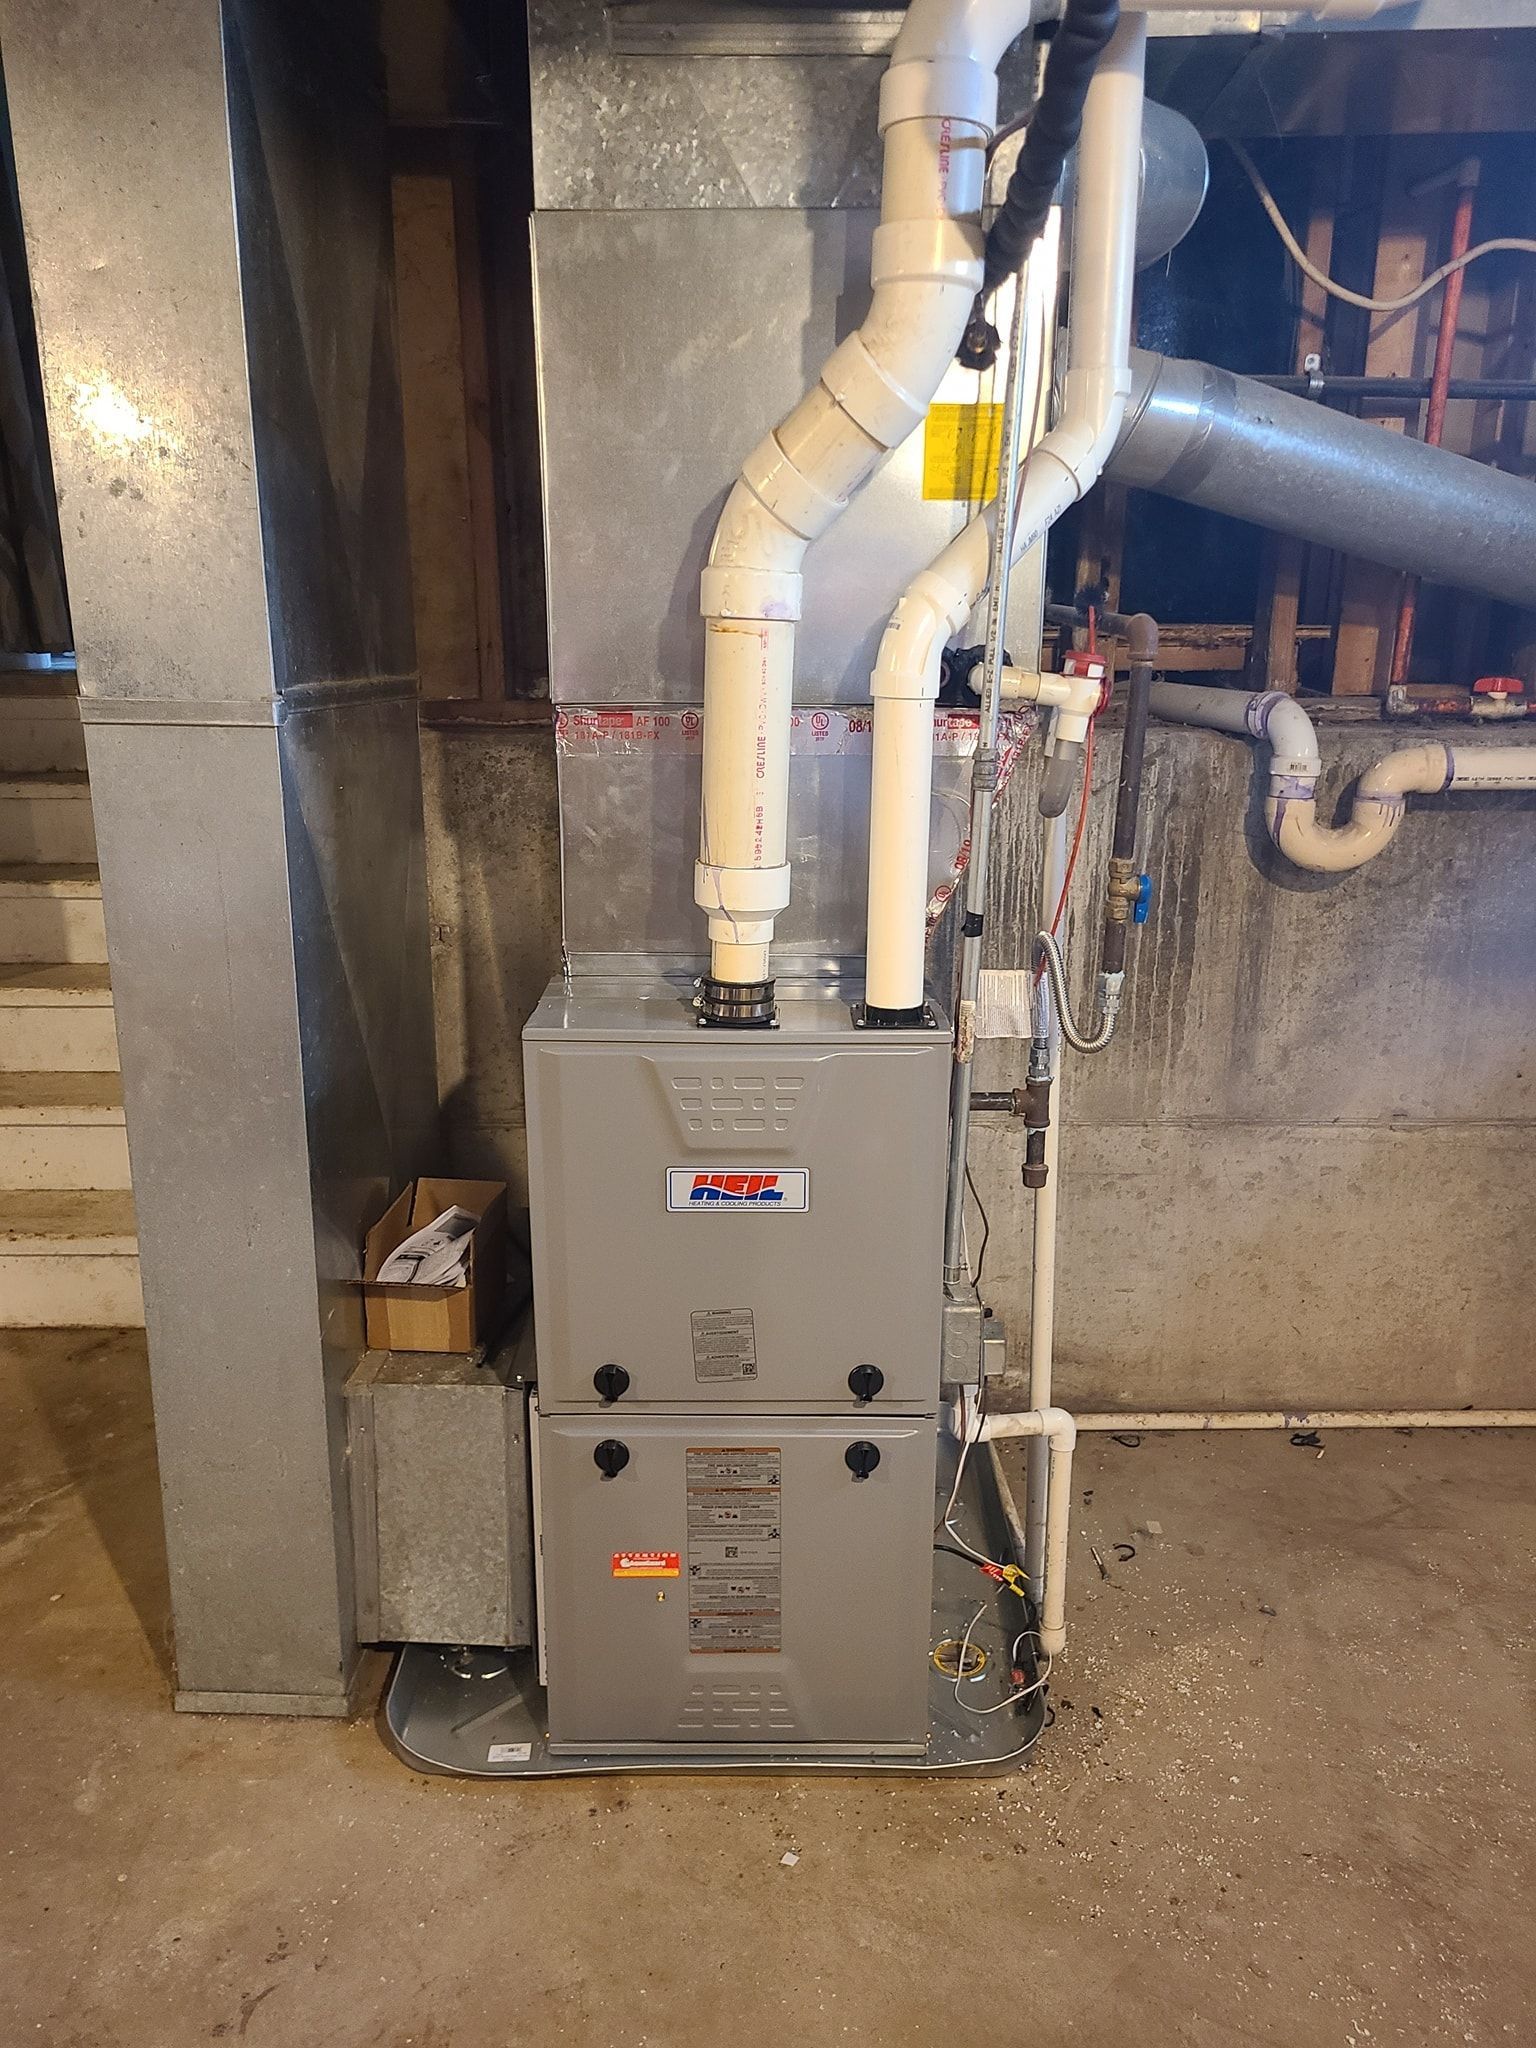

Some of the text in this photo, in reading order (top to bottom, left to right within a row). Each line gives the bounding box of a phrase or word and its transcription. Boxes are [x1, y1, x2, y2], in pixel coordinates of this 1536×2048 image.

[992, 596, 1000, 612] EMT
[989, 630, 997, 642] 1/2
[986, 669, 994, 684] E-Z
[984, 687, 993, 714] ALLIED
[636, 716, 650, 727] AF
[653, 716, 670, 727] 100
[848, 719, 872, 733] 08/1
[954, 839, 971, 870] 08/10
[689, 1174, 784, 1201] HEIL
